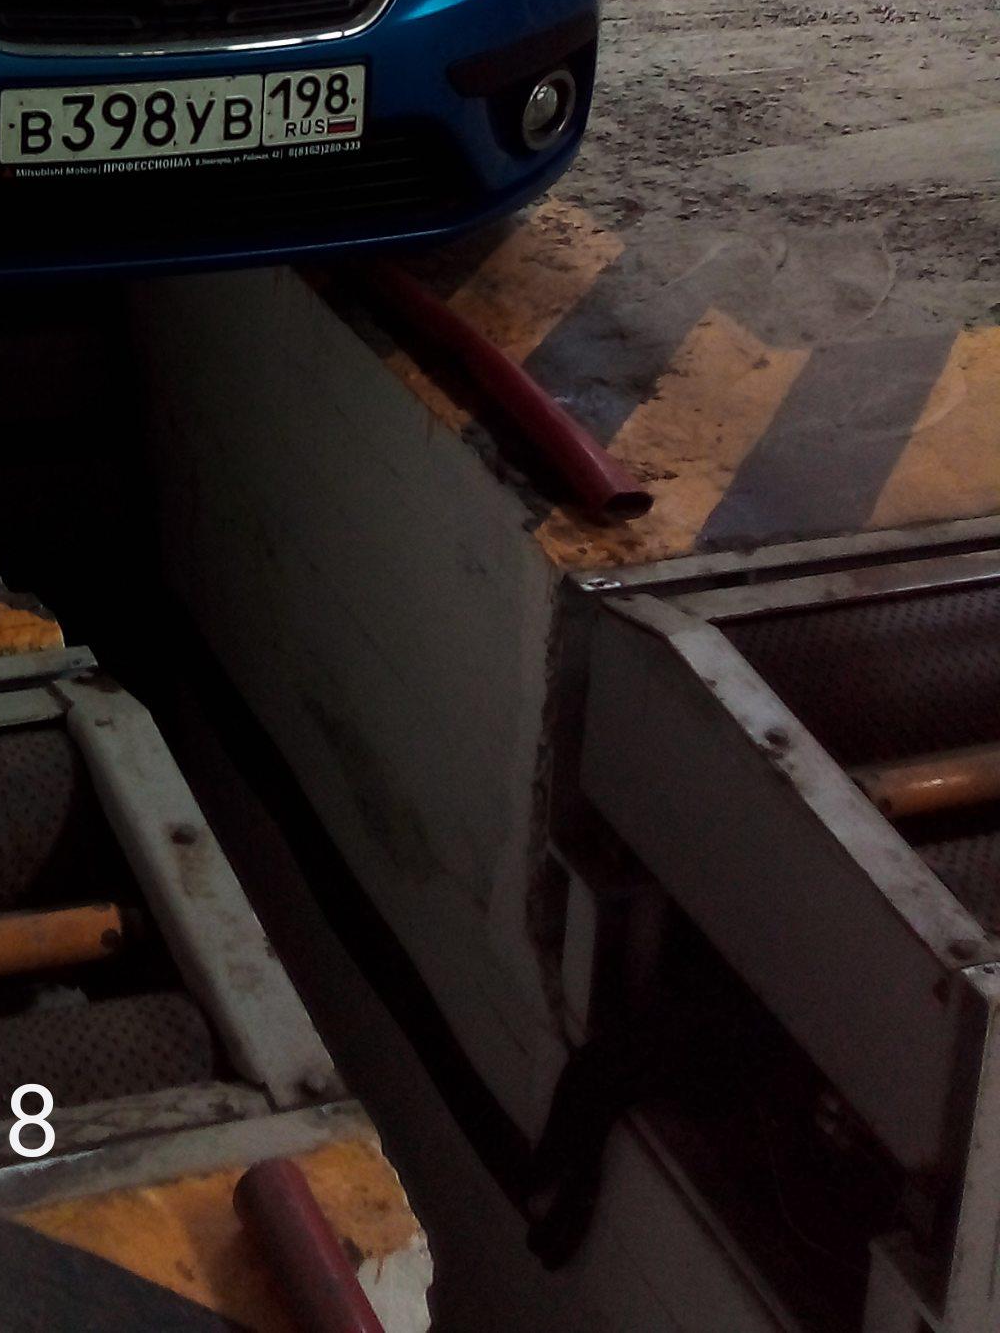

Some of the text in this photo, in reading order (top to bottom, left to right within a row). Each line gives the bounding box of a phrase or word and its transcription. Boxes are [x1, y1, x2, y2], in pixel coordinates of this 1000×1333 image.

[20, 71, 350, 155] В398УВ 198
[285, 120, 326, 138] RUS
